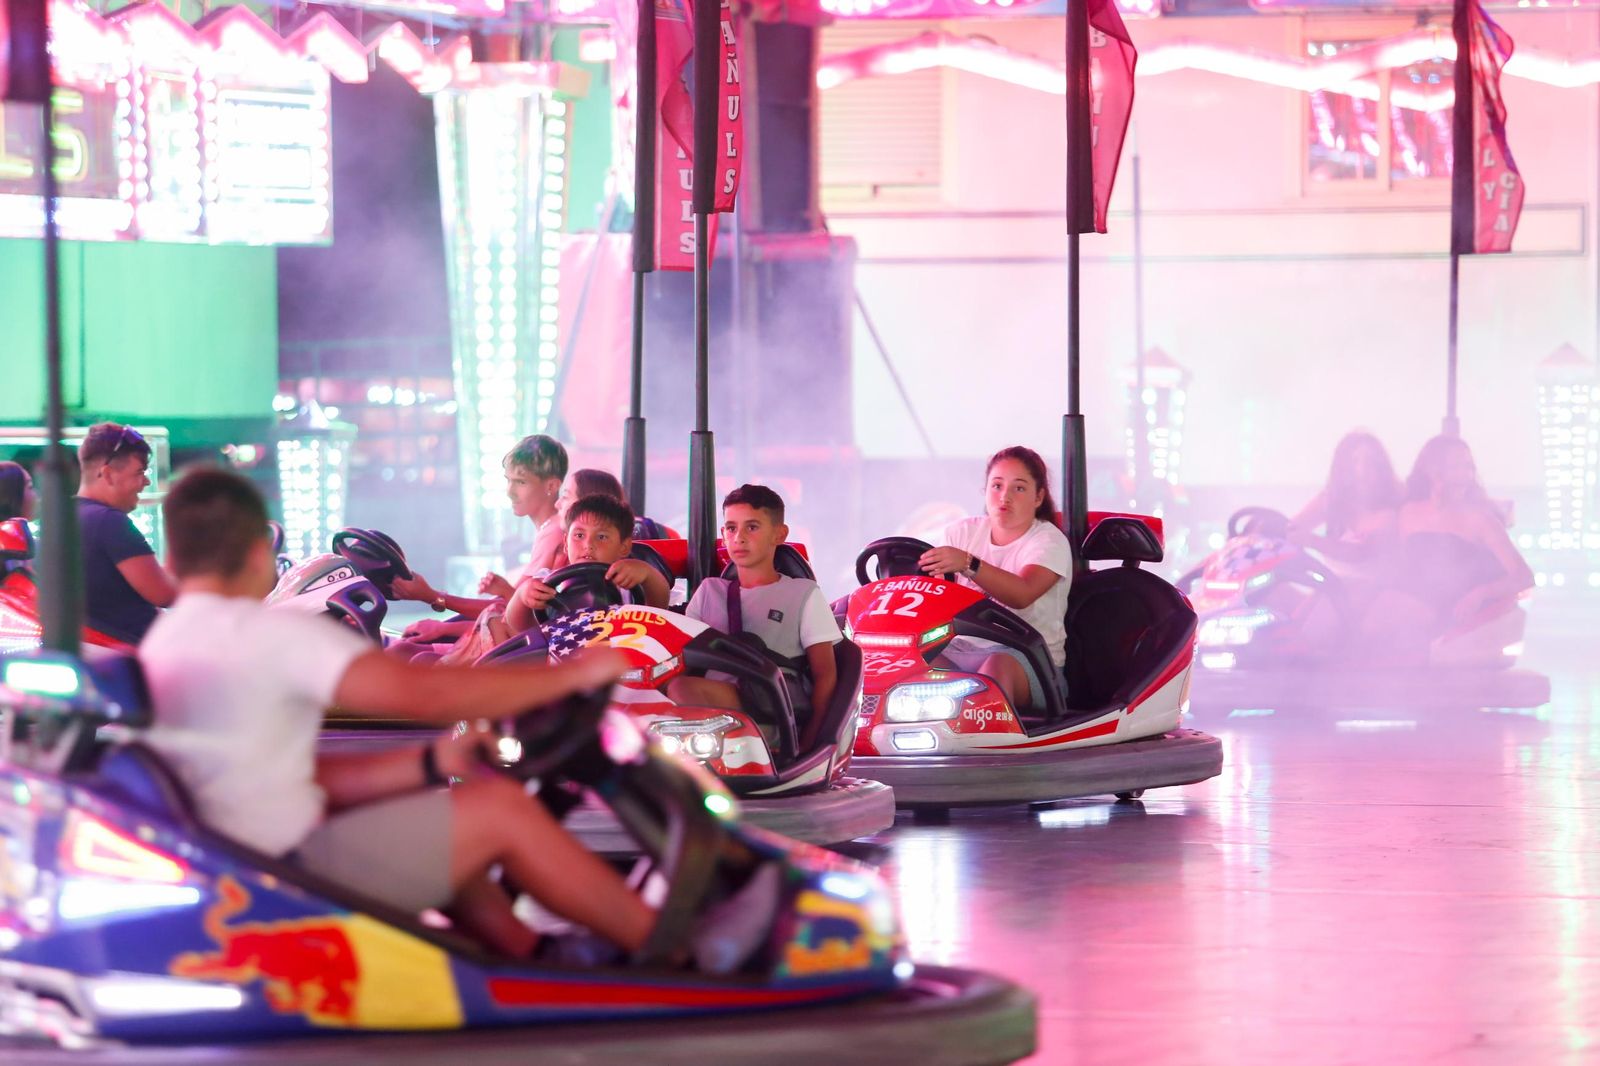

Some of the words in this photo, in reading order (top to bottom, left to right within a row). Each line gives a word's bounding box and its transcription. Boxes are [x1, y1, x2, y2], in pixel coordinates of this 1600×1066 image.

[719, 0, 741, 195] AÑULS
[869, 592, 925, 618] 12
[584, 622, 648, 650] 22
[963, 708, 993, 731] aigo
